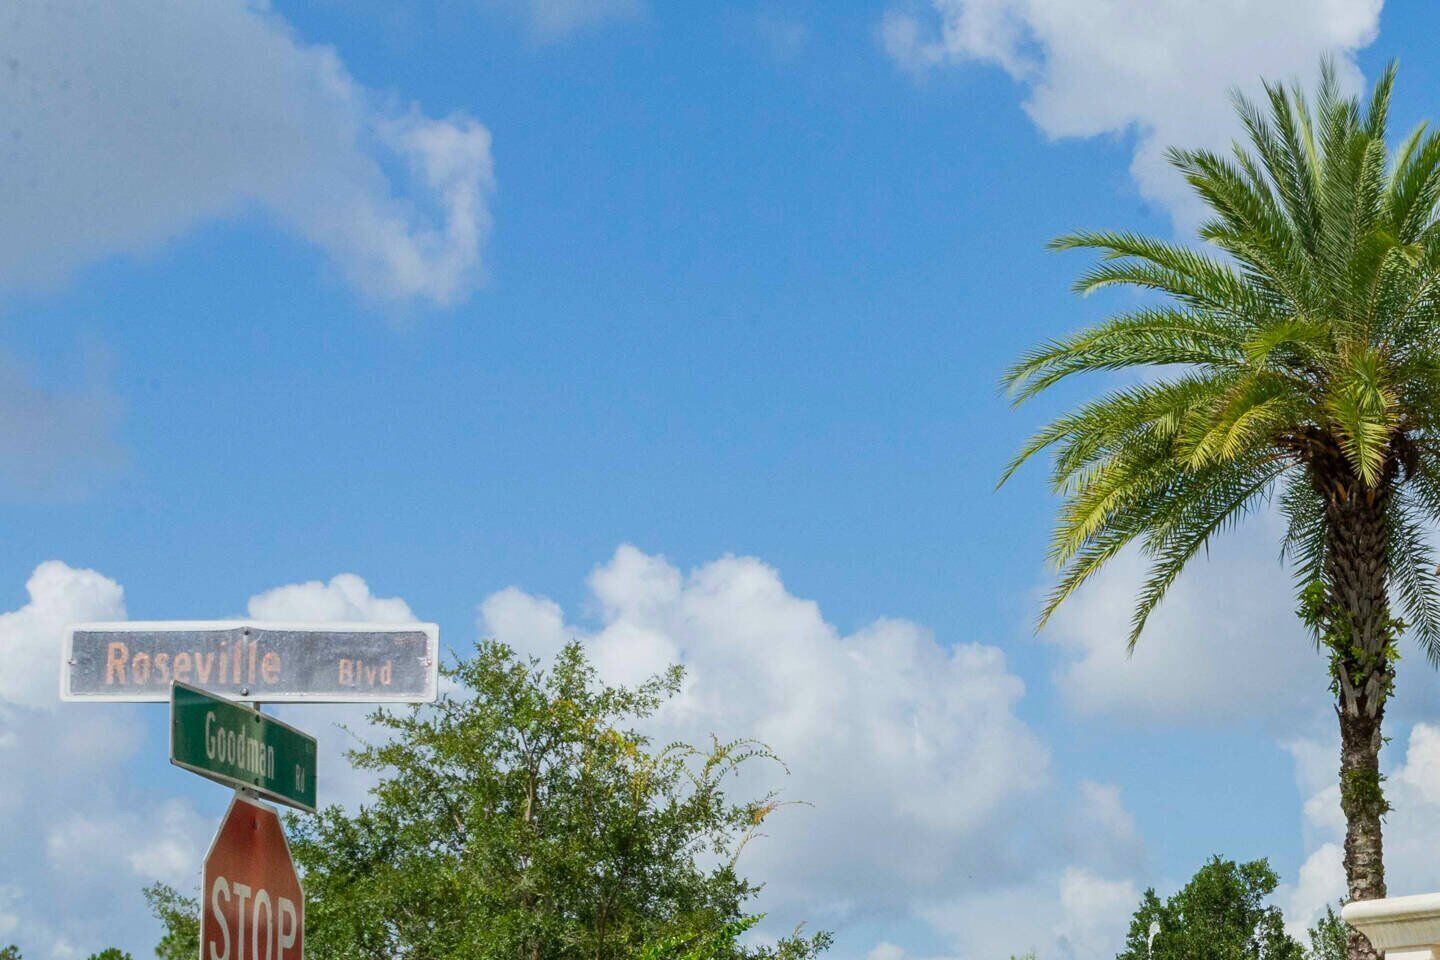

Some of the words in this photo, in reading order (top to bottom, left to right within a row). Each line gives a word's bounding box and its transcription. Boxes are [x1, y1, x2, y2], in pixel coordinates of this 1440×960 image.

[105, 640, 281, 685] Roseville
[338, 656, 392, 686] Blvd
[205, 711, 275, 779] Goodman
[295, 763, 305, 794] Rd
